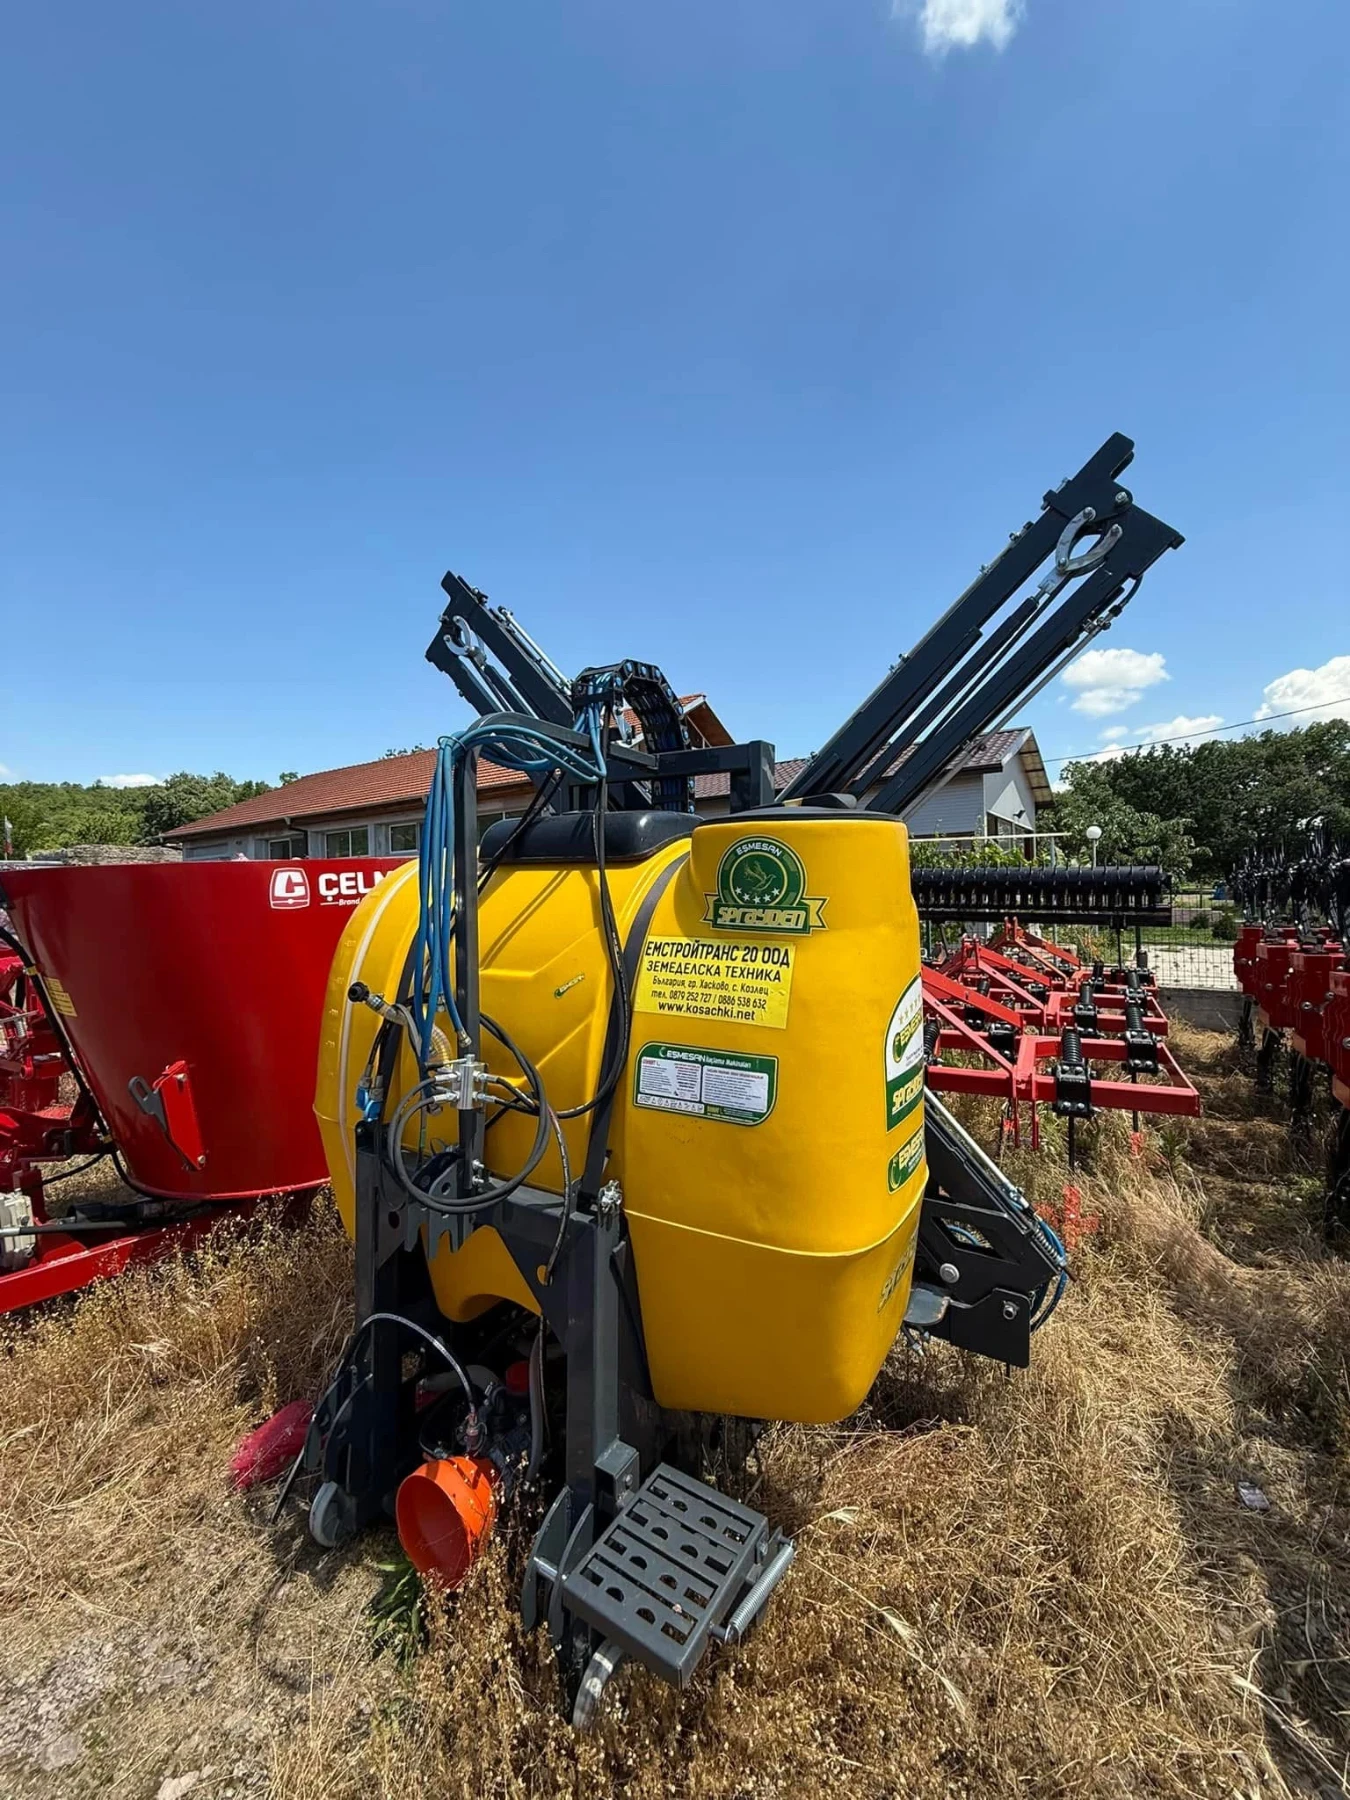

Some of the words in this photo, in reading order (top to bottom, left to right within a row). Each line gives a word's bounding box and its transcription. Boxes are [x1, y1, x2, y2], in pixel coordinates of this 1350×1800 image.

[736, 842, 782, 856] ESMESAN
[645, 940, 740, 962] ЕМСТРОЙТРАНС
[741, 946, 759, 963] 20
[762, 947, 790, 968] ООД
[646, 960, 721, 977] ЗЕМЕДЕЛСКА
[725, 965, 781, 982] ТЕХНИКА
[687, 981, 698, 989] гр.
[699, 979, 730, 992] Хасково,
[740, 983, 769, 996] Козлец
[651, 990, 667, 999] тел.
[669, 990, 685, 1001] 0879
[686, 992, 699, 1002] 252
[700, 993, 712, 1003] 727
[737, 996, 751, 1007] 538
[752, 998, 767, 1010] 632
[658, 1001, 755, 1021] www.kosachki.net
[666, 1050, 706, 1063] ESMESAN
